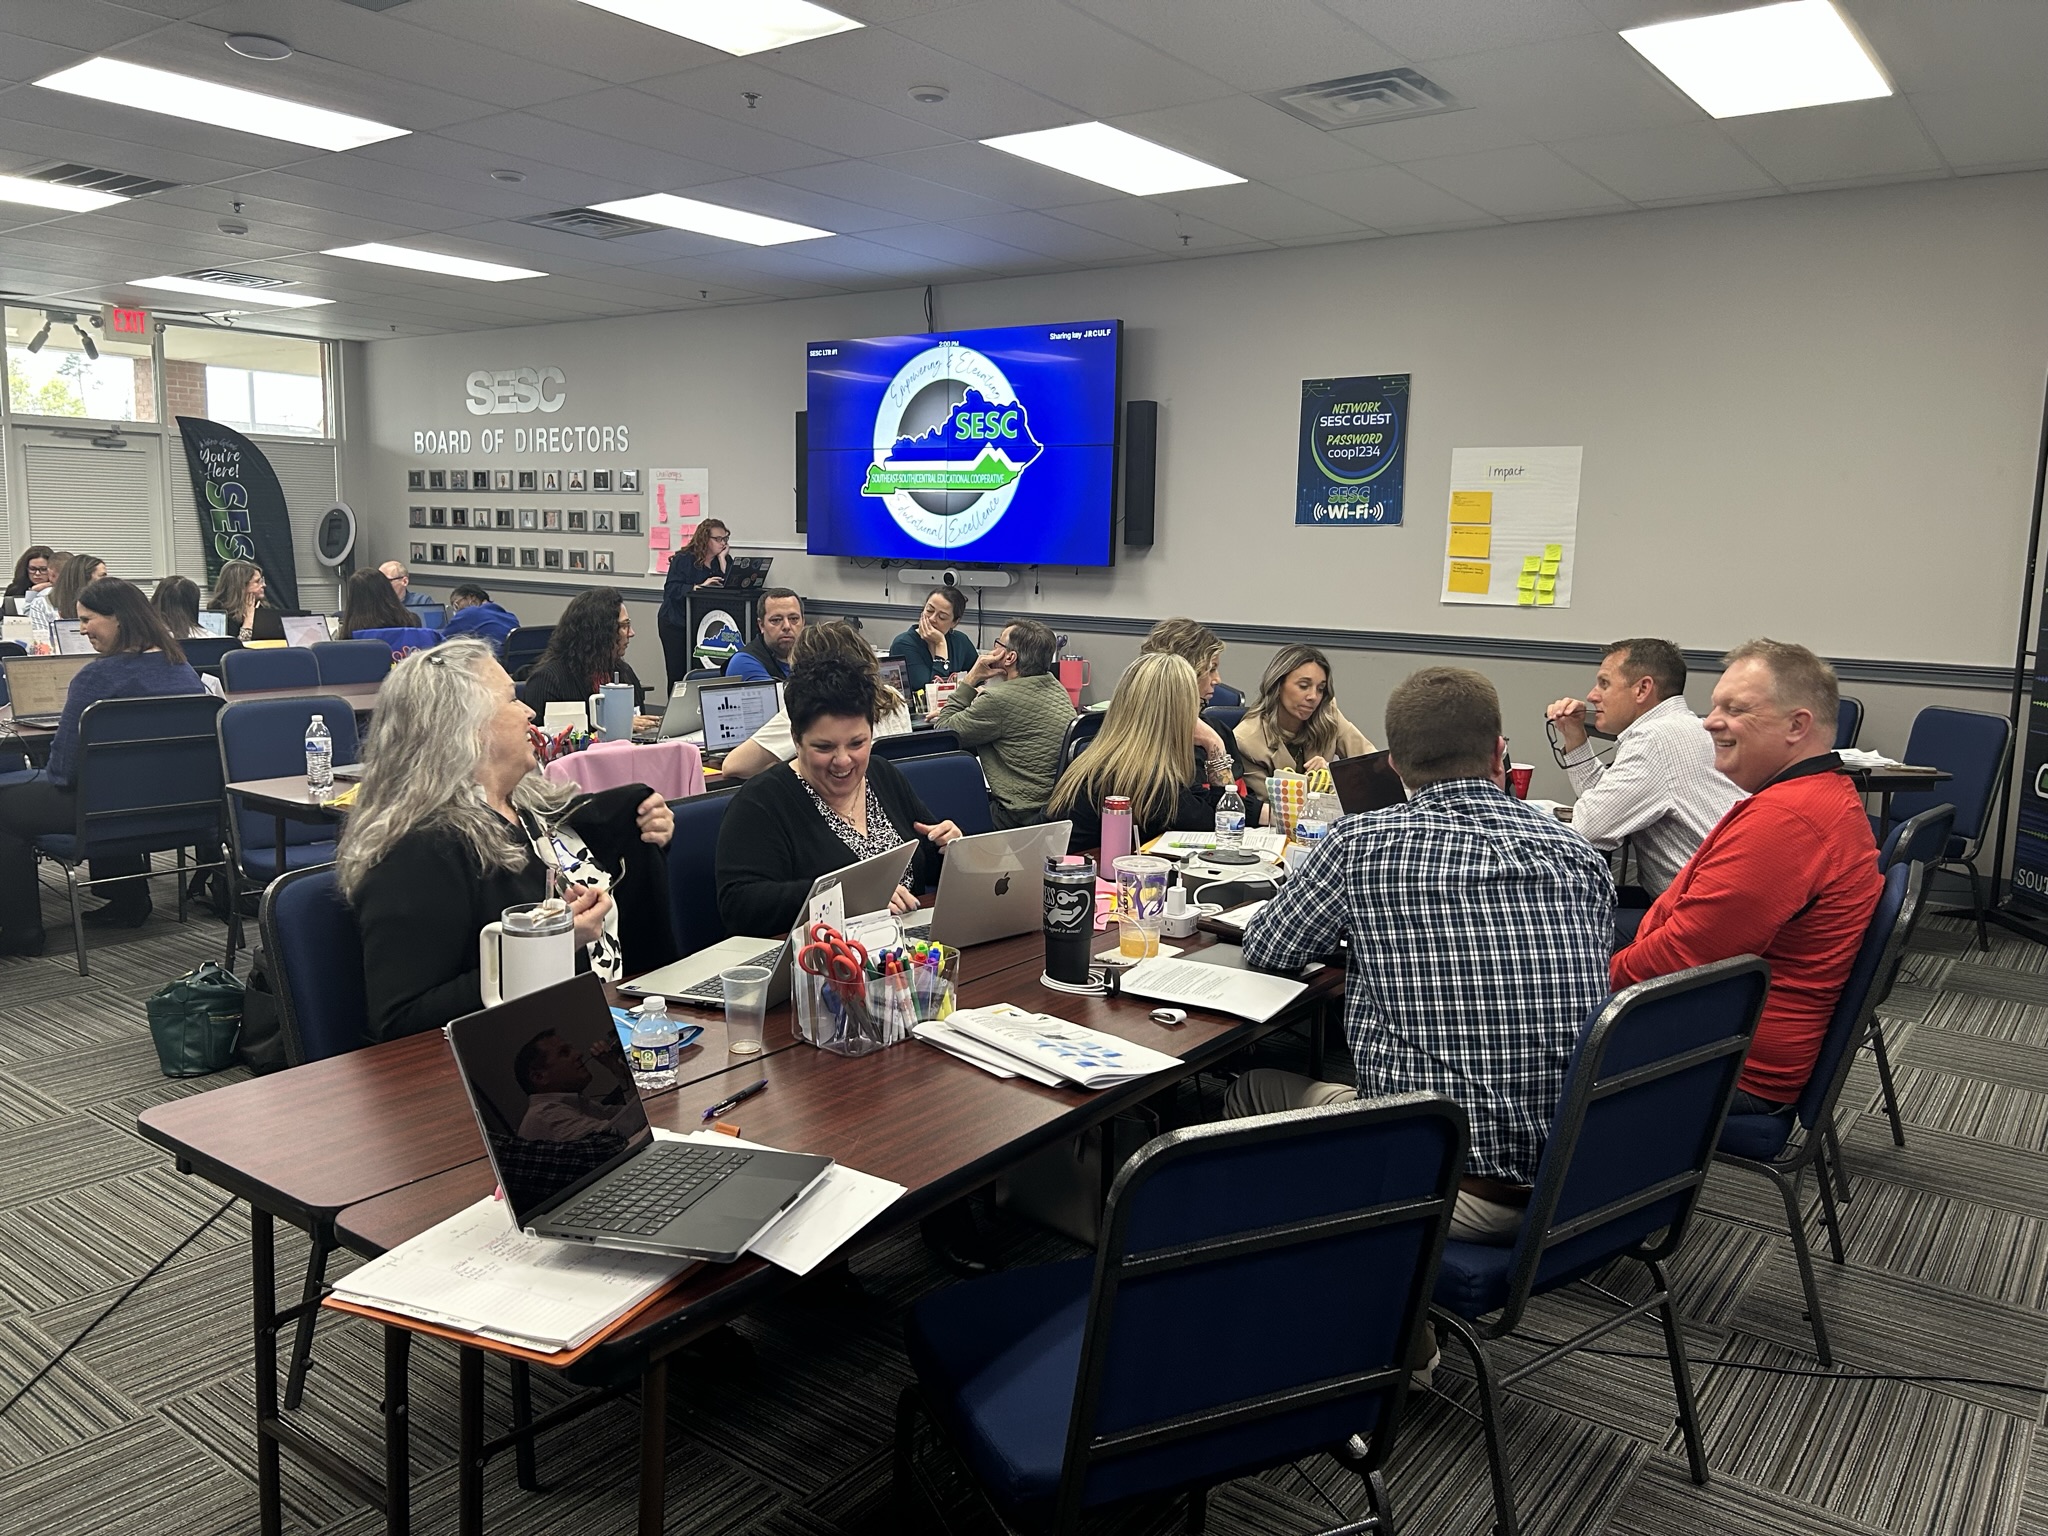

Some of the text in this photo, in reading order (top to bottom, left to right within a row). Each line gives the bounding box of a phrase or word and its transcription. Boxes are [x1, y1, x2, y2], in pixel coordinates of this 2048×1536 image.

[113, 308, 147, 335] EXIT
[1050, 332, 1072, 341] Sharing
[1083, 329, 1111, 338] JRCULF
[465, 366, 567, 416] SESC
[1331, 401, 1381, 414] NETWORK
[955, 410, 1018, 441] SESC
[1319, 413, 1392, 427] SESC GUEST
[414, 425, 629, 455] BOARD OF DIRECTORS
[1326, 432, 1383, 446] PASSWORD
[199, 448, 240, 464] You're
[1327, 445, 1381, 461] coop1234
[204, 462, 240, 479] Here!
[937, 473, 970, 484] EDUCATIONAL
[970, 473, 1005, 484] COOPERATIVE
[1488, 465, 1525, 481] Impact
[1328, 485, 1371, 504] SESC
[1327, 503, 1370, 520] Wi-Fi
[205, 480, 255, 561] SES
[948, 497, 1000, 544] Excellence
